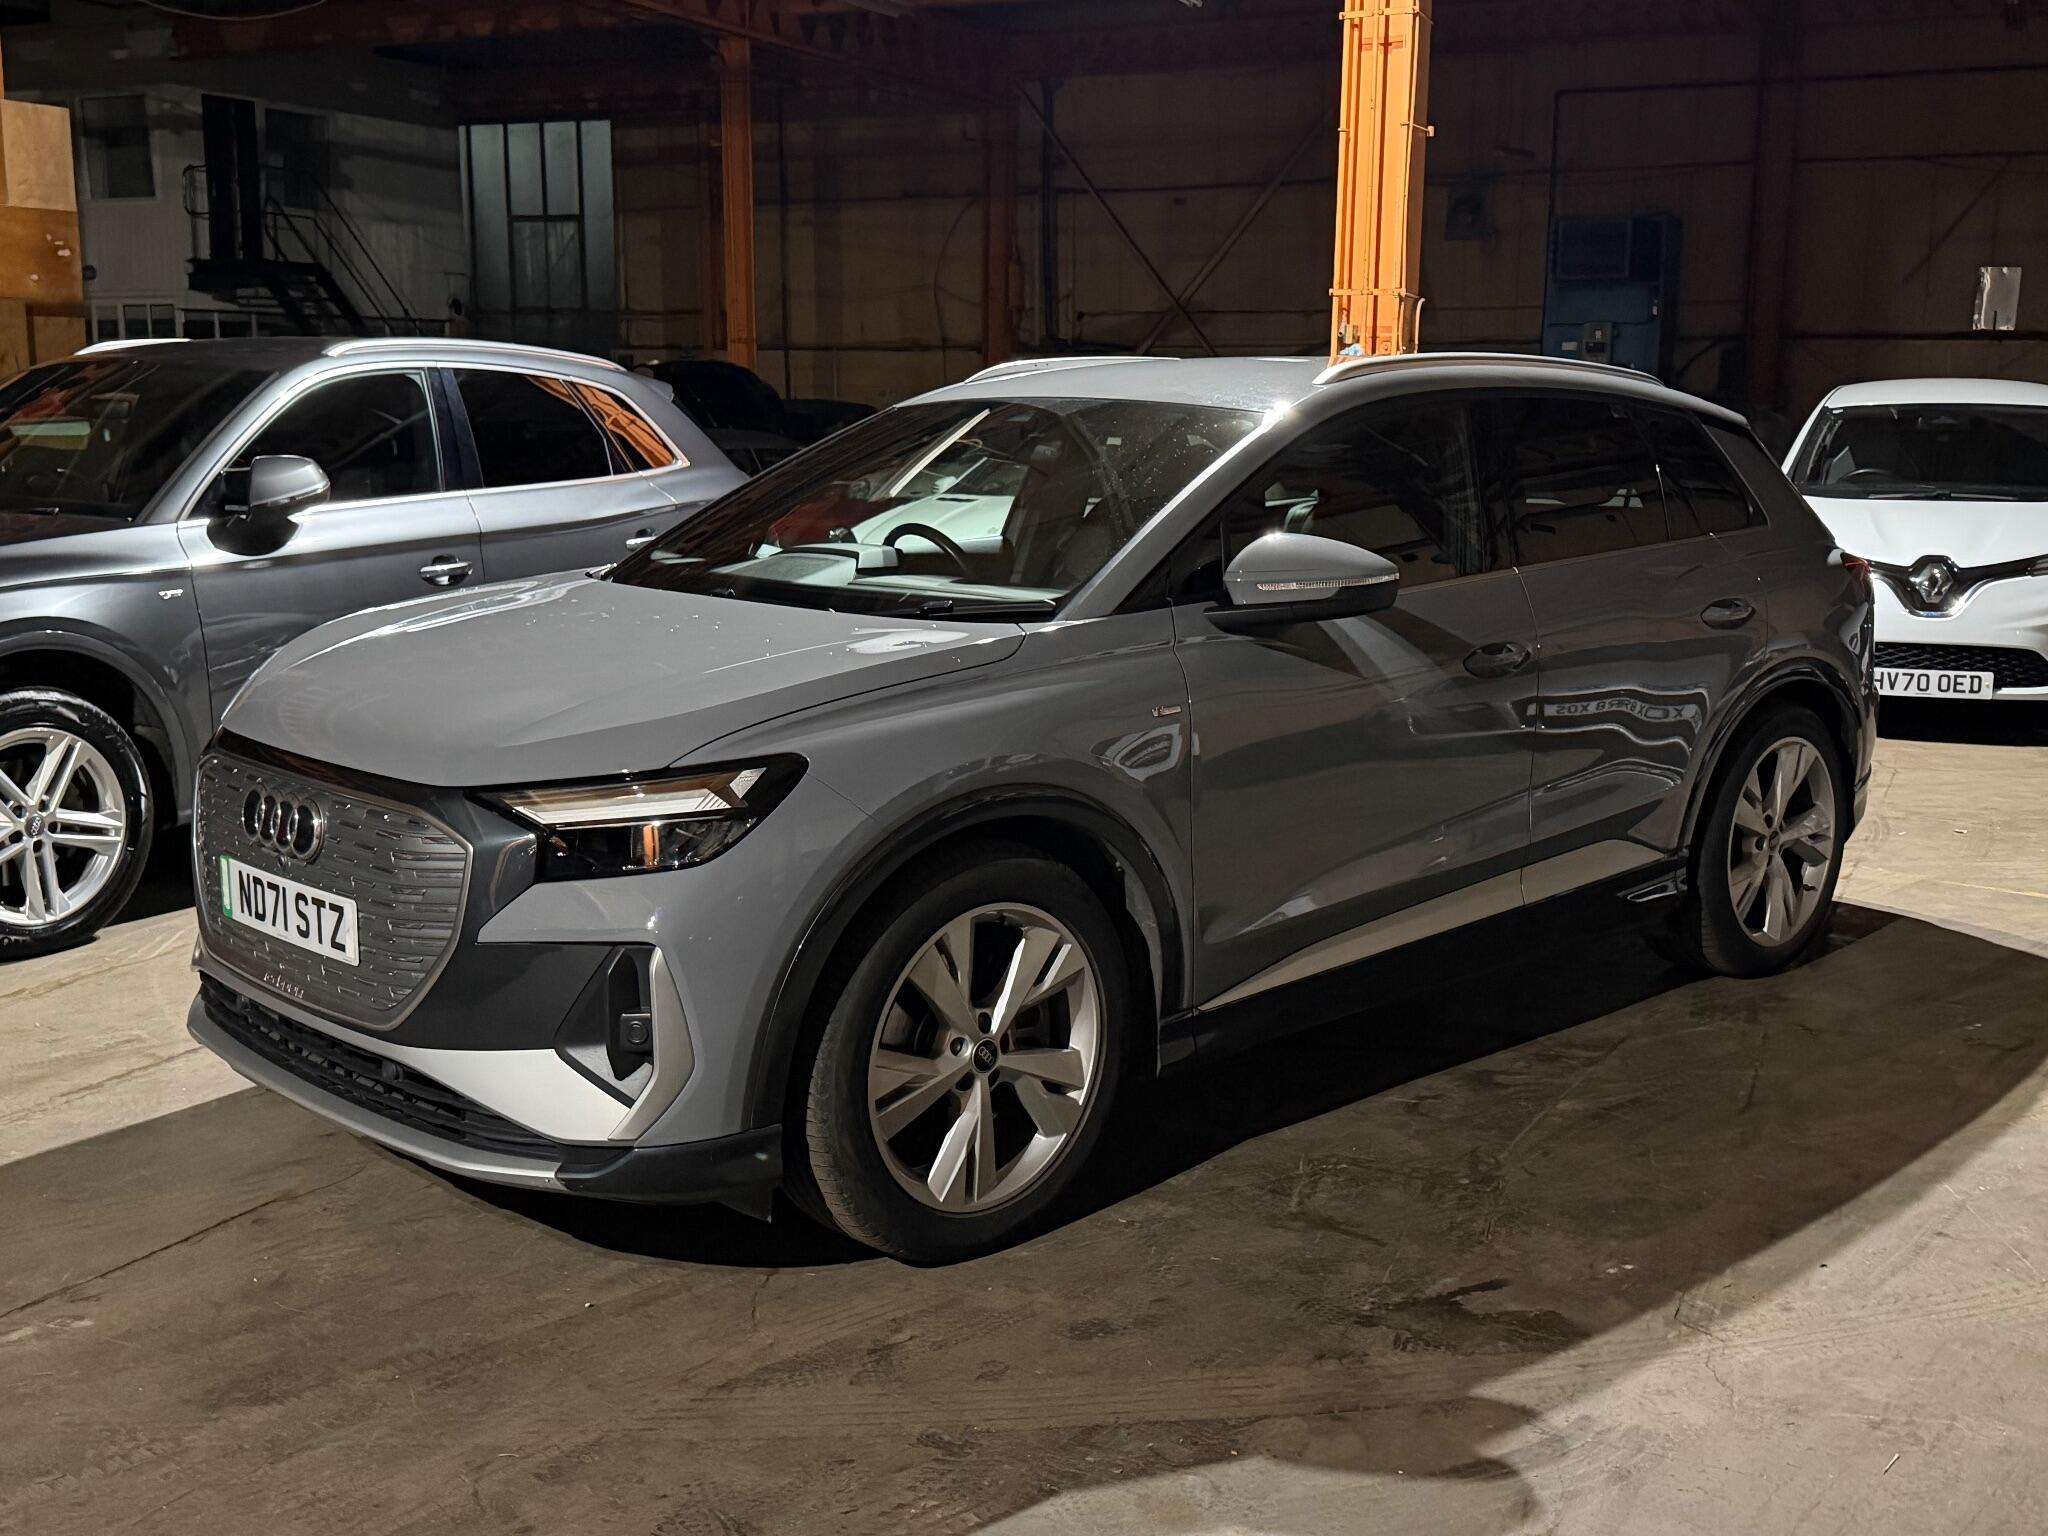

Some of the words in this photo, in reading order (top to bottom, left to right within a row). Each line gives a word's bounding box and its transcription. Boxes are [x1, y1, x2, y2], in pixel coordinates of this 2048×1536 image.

[1937, 674, 1982, 694] OED
[238, 870, 289, 932] ND71
[295, 892, 347, 953] STZ
